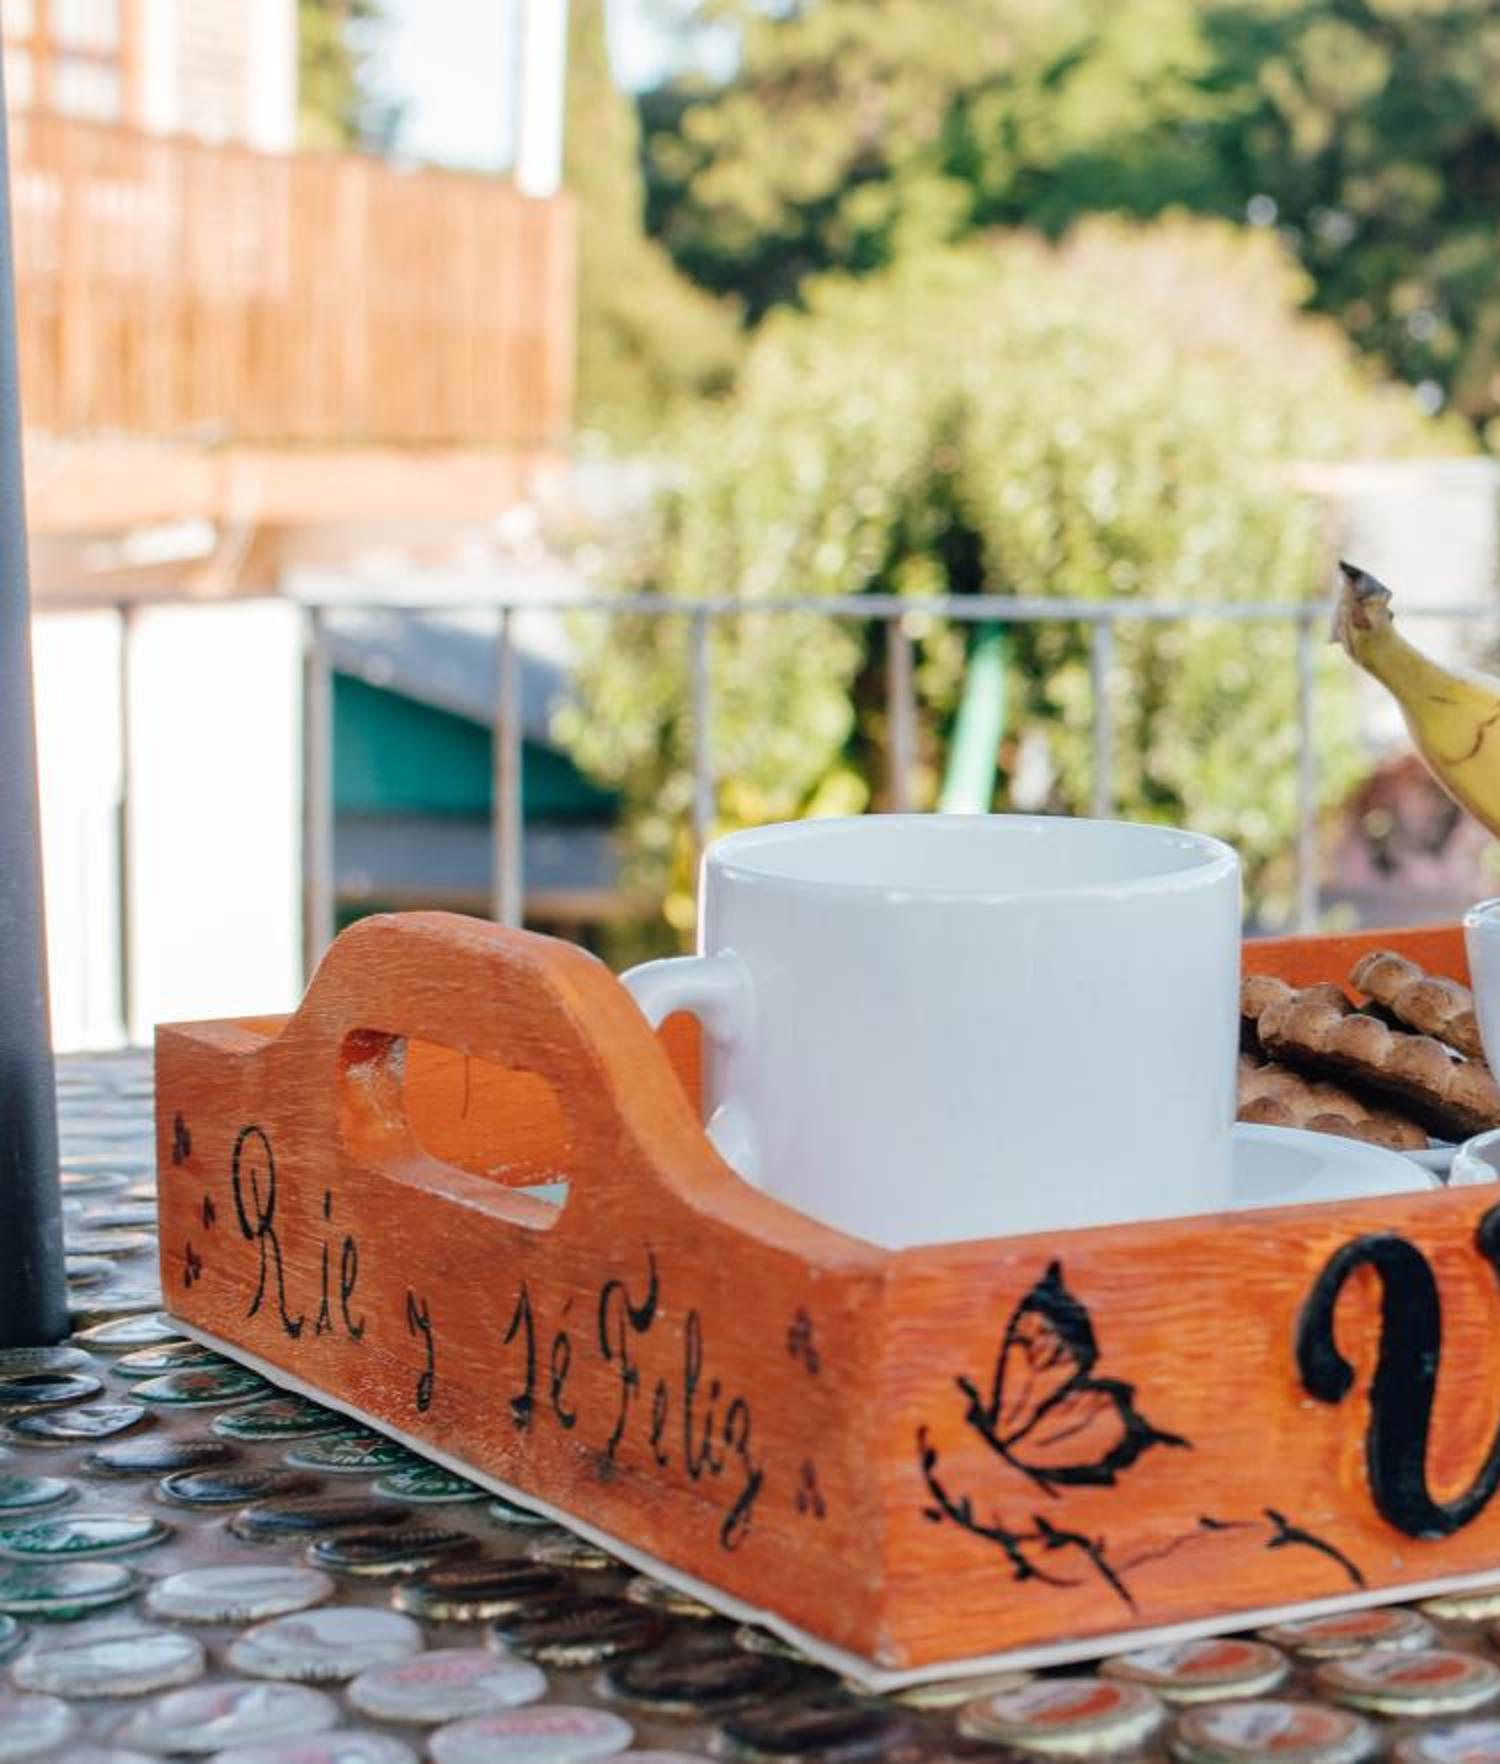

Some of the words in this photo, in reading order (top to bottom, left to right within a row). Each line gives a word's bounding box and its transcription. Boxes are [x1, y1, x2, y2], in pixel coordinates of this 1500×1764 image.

[231, 1124, 367, 1339] Rie
[406, 1287, 435, 1413] y
[597, 1244, 762, 1551] Feliz
